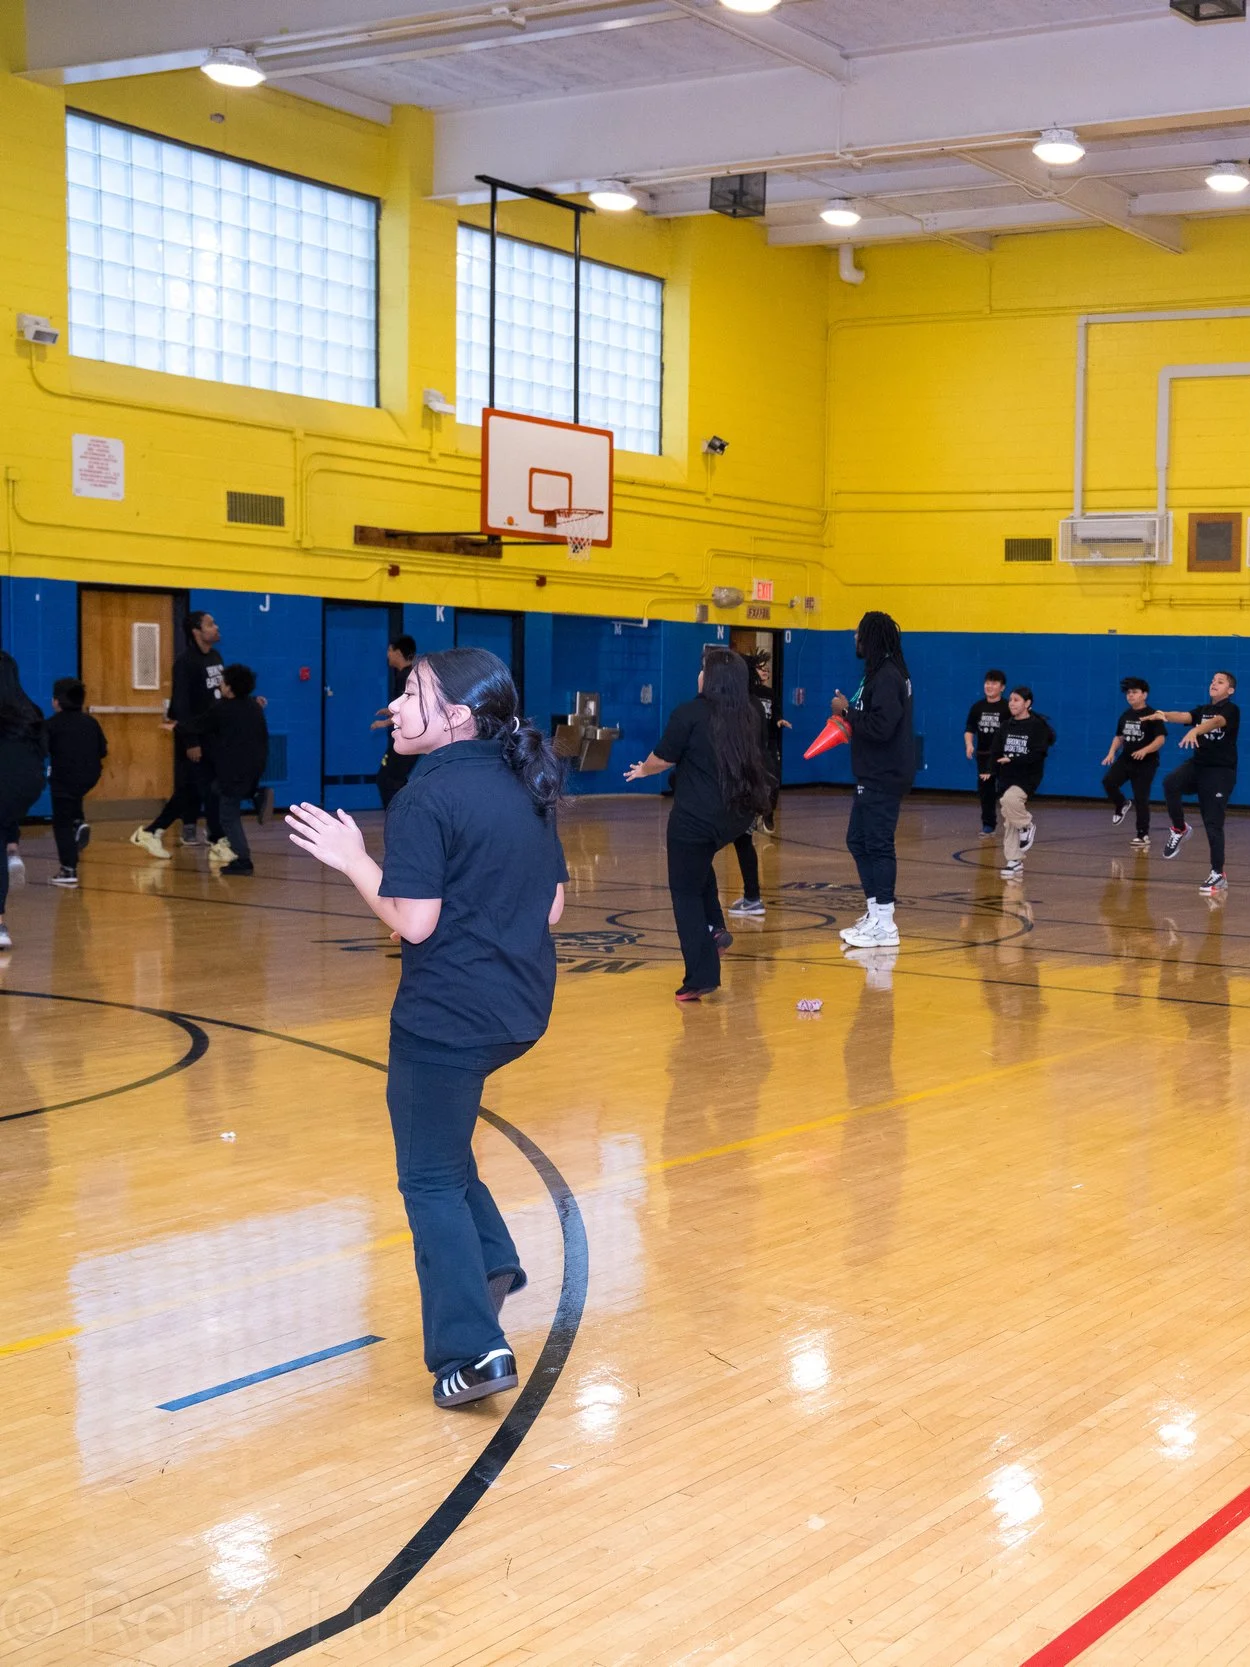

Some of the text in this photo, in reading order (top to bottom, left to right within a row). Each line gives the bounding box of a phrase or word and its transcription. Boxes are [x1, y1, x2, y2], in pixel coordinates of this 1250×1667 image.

[757, 583, 772, 600] EXIT
[259, 594, 270, 612] J
[436, 605, 445, 622] K
[717, 625, 724, 640] N
